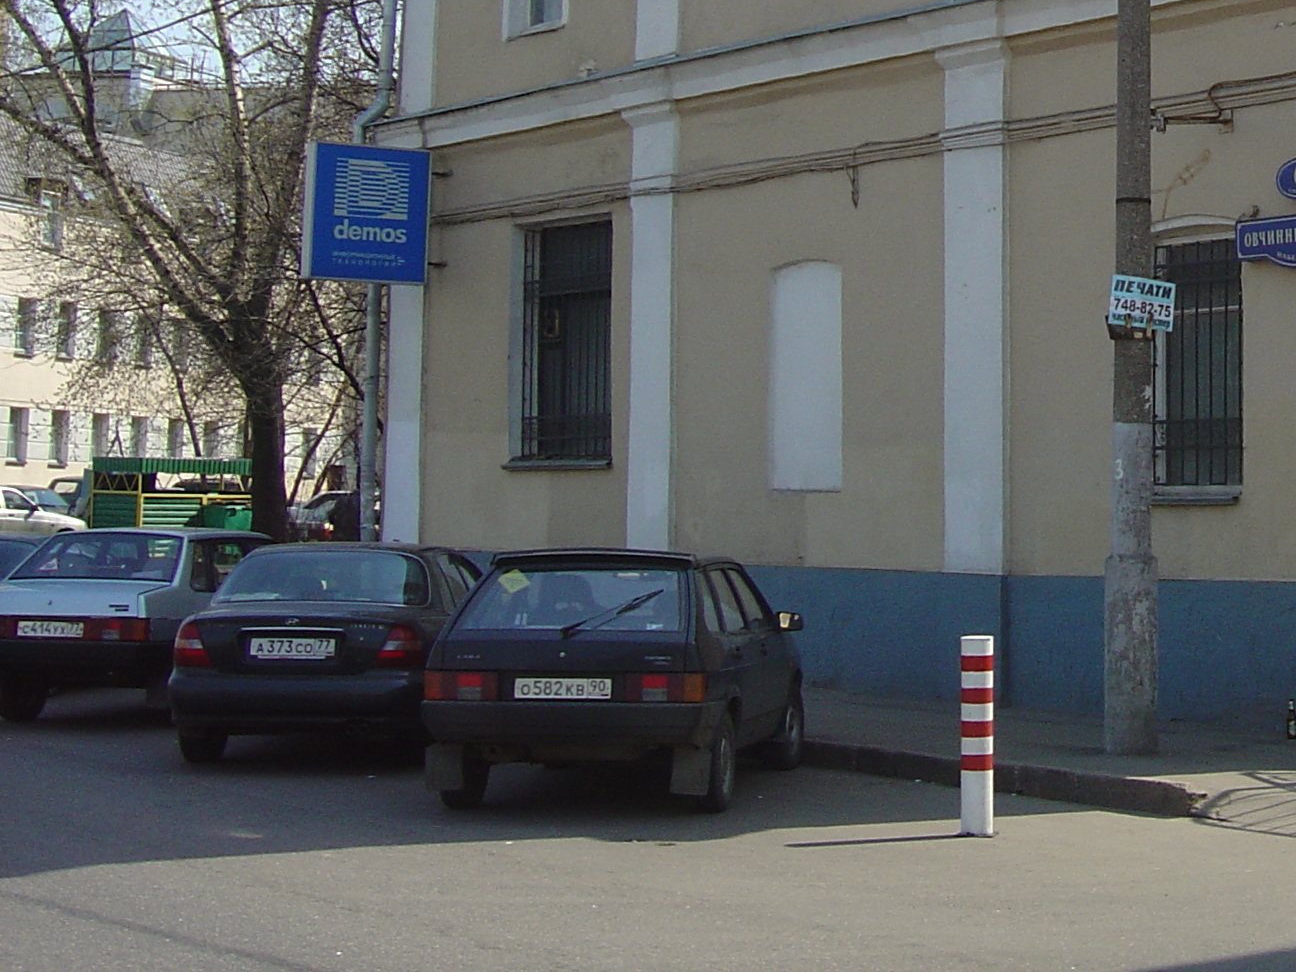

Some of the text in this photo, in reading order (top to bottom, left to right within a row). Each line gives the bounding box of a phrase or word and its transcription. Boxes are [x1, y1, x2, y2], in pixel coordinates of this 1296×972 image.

[333, 218, 407, 244] demos
[1113, 279, 1172, 300] ПЕЧАТИ
[1114, 298, 1171, 318] 748-82-75
[256, 639, 331, 654] А373СО 77
[520, 680, 606, 696] О582КВ 90
